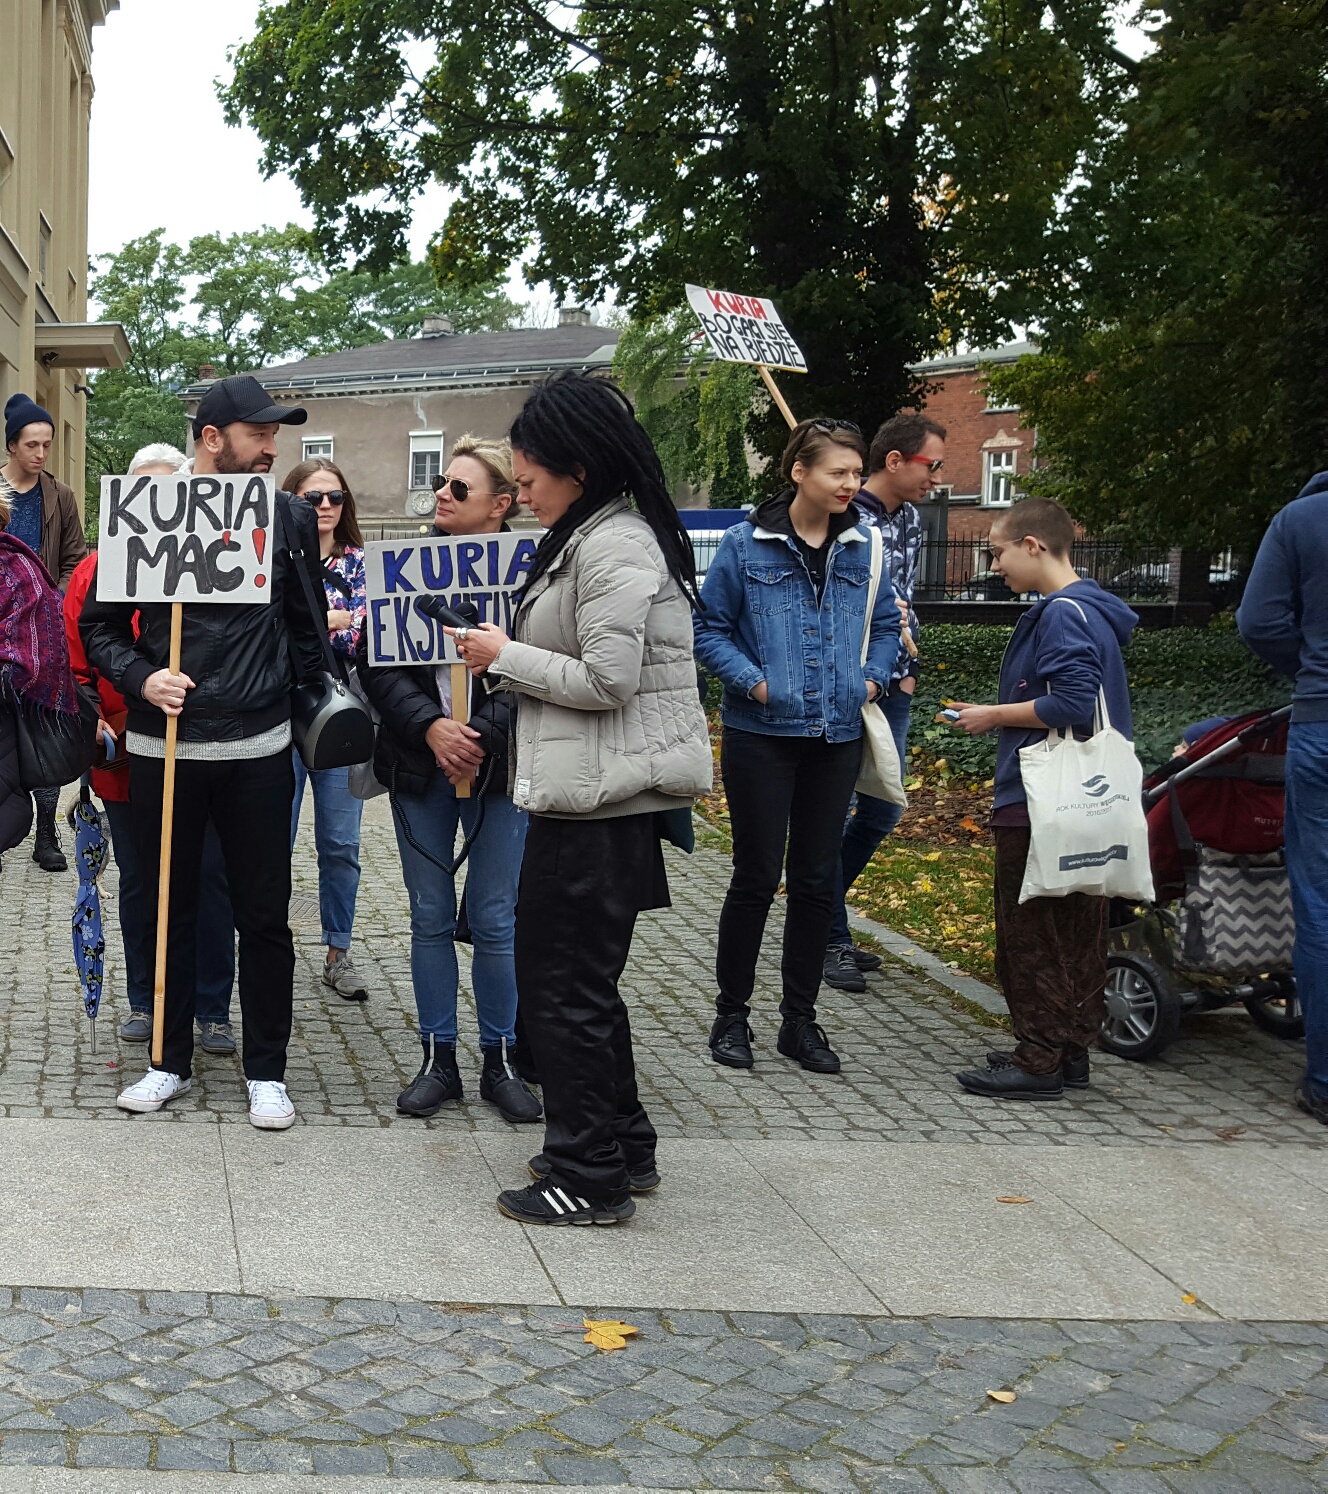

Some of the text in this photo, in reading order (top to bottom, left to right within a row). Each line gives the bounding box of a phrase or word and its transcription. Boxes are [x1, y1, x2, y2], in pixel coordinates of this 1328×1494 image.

[698, 313, 766, 340] BOGACI
[706, 289, 768, 320] KURIA
[710, 333, 806, 368] NA BIEDZIE
[108, 476, 270, 537] KURIA
[125, 528, 267, 597] MAĆ!
[382, 539, 537, 593] KURIA
